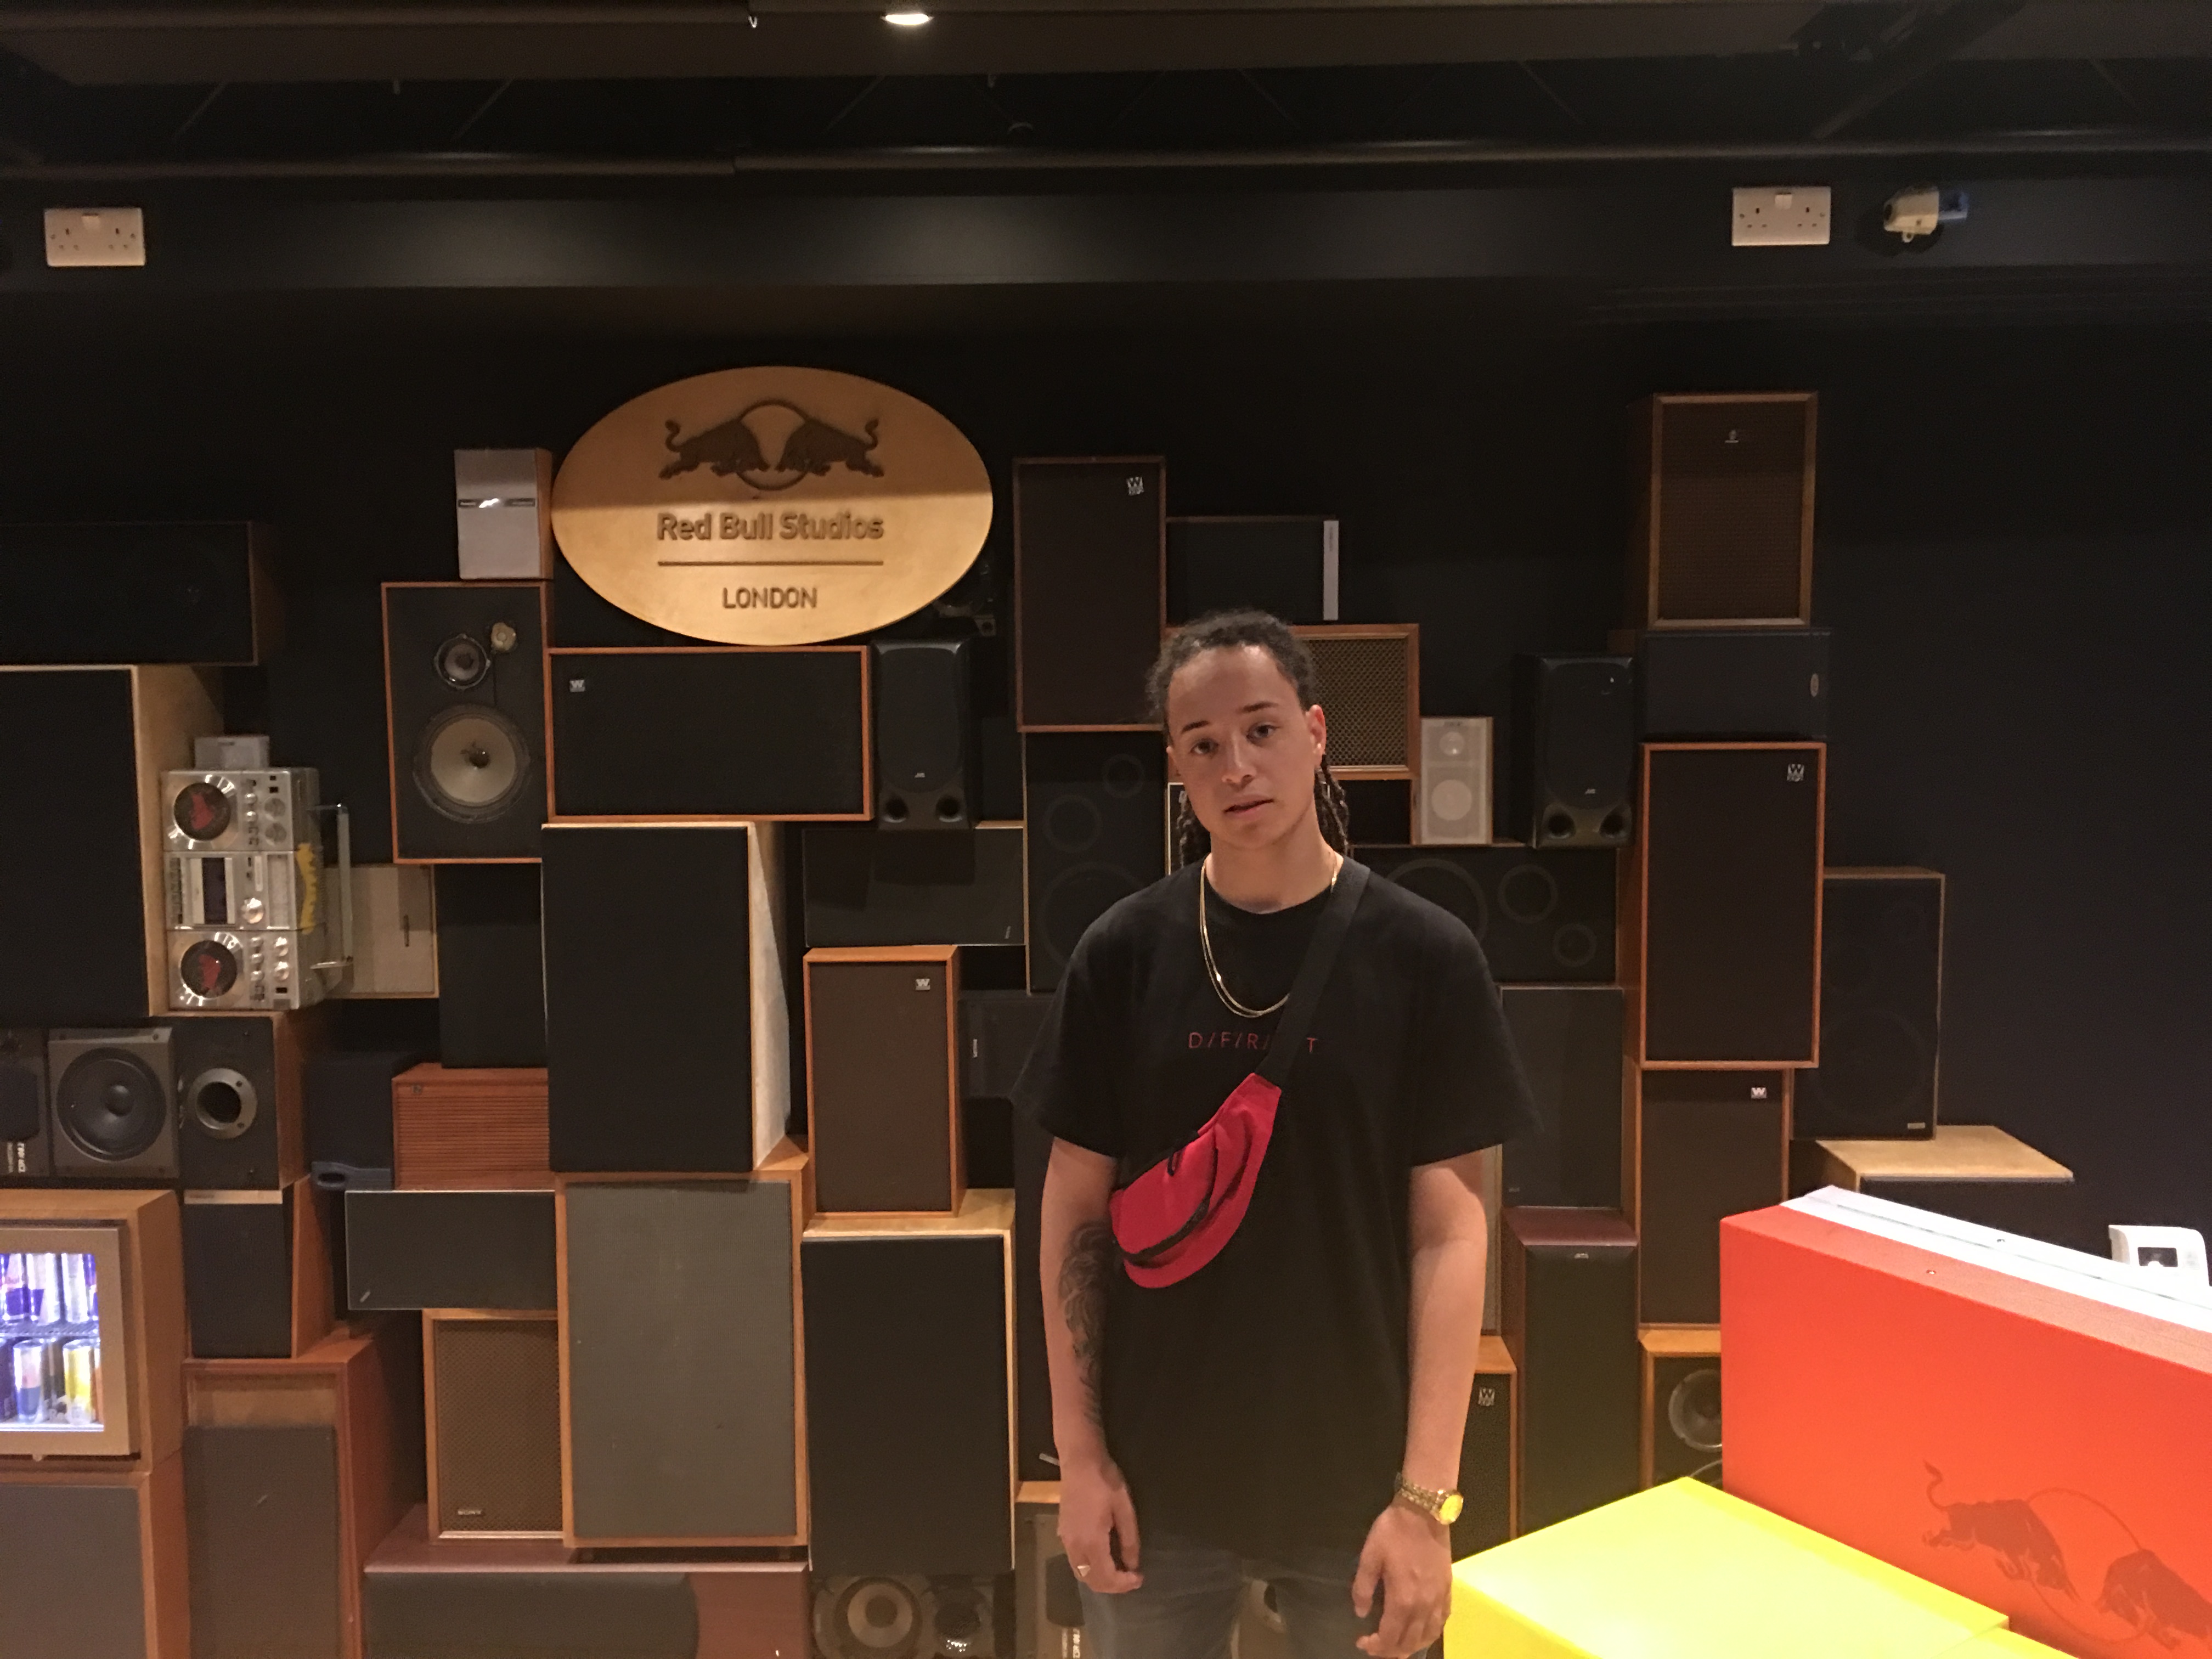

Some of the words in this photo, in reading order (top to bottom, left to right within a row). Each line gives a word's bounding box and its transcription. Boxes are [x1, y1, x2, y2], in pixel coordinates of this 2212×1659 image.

[658, 513, 710, 540] Red
[719, 513, 772, 540] Bull
[780, 512, 884, 540] Studios
[723, 586, 817, 609] LONDON
